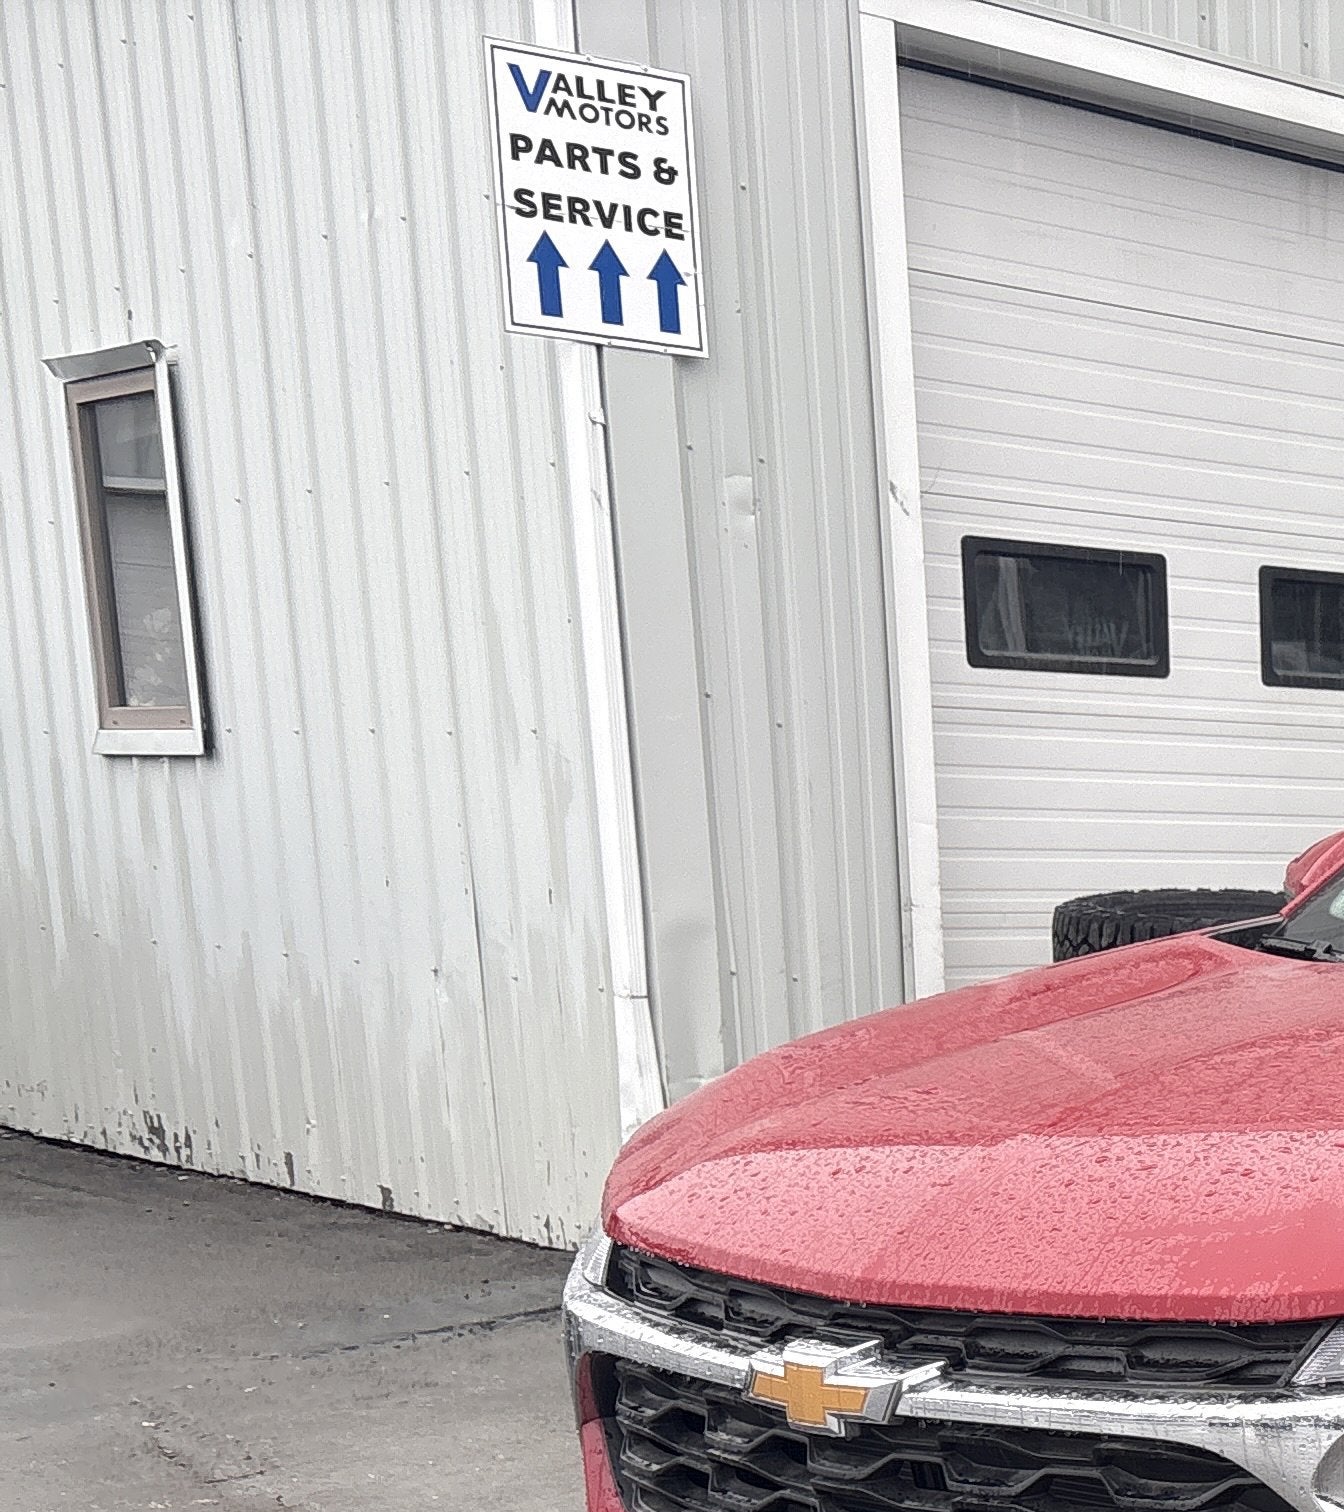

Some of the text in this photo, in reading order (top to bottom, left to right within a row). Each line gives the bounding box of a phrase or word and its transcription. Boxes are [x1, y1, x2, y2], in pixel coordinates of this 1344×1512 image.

[507, 61, 667, 113] VALLEY
[543, 97, 670, 136] MOTORS
[509, 132, 679, 185] PARTS &
[513, 187, 685, 241] SERVICE
